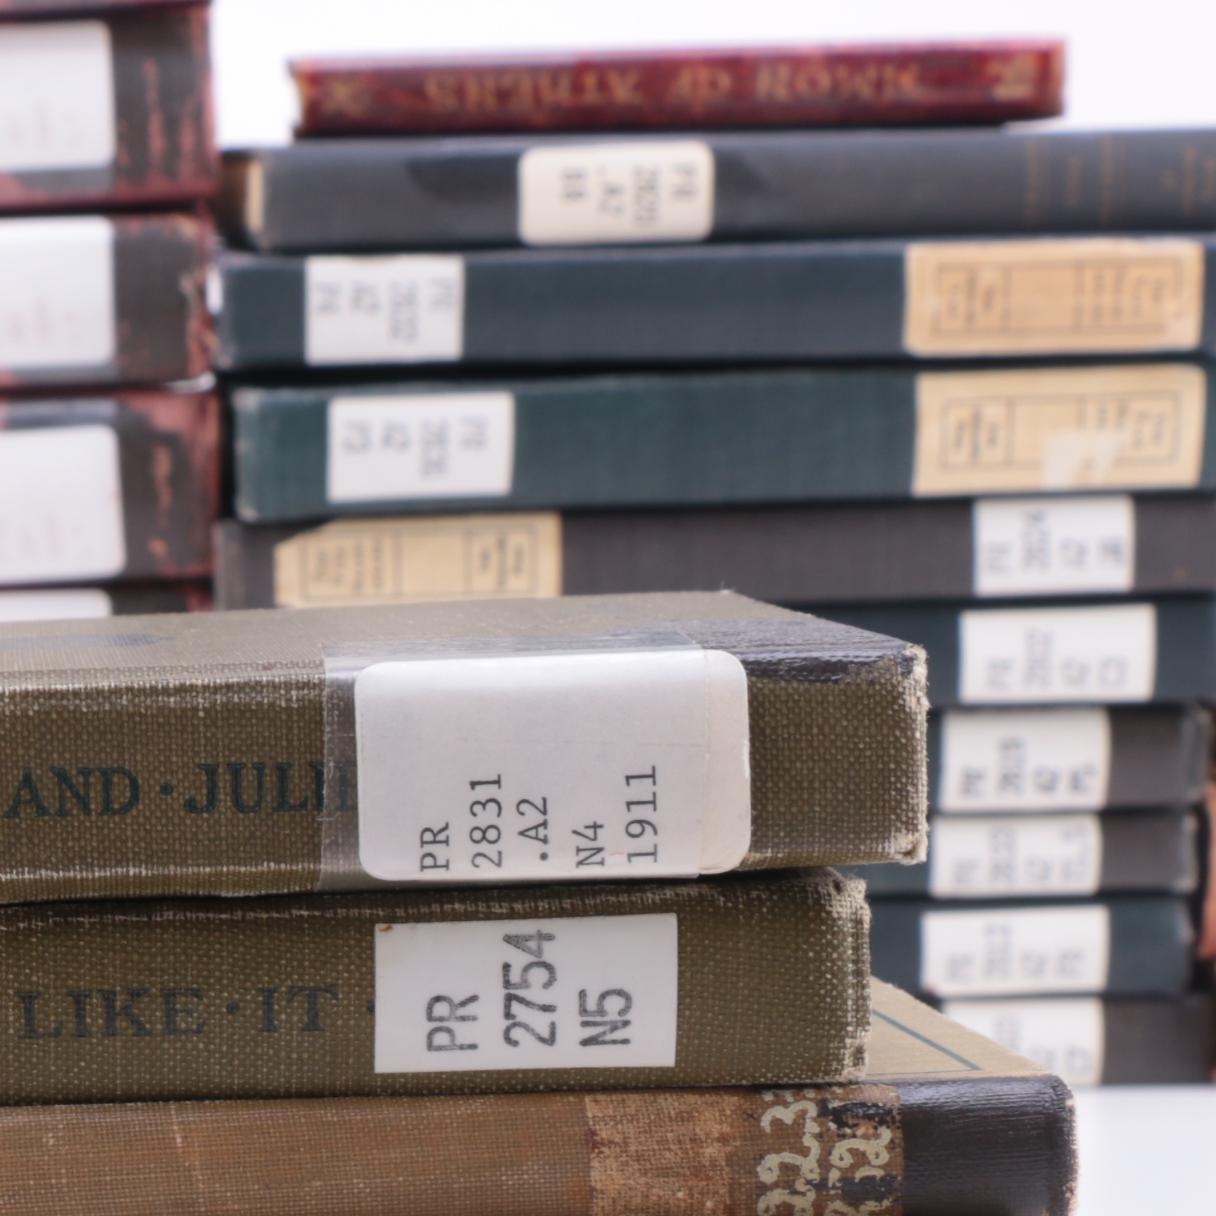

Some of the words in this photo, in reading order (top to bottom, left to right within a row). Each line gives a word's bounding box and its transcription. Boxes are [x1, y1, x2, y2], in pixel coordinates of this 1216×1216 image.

[2, 765, 142, 820] AND
[469, 772, 503, 869] 2831
[624, 764, 658, 865] 1911
[420, 821, 450, 872] PR
[516, 796, 549, 861] .A2
[571, 820, 606, 869] N4
[15, 986, 205, 1040] LIKE
[257, 984, 339, 1034] IT
[502, 928, 557, 1048] 2754
[578, 987, 633, 1047] N5
[425, 993, 480, 1052] PR
